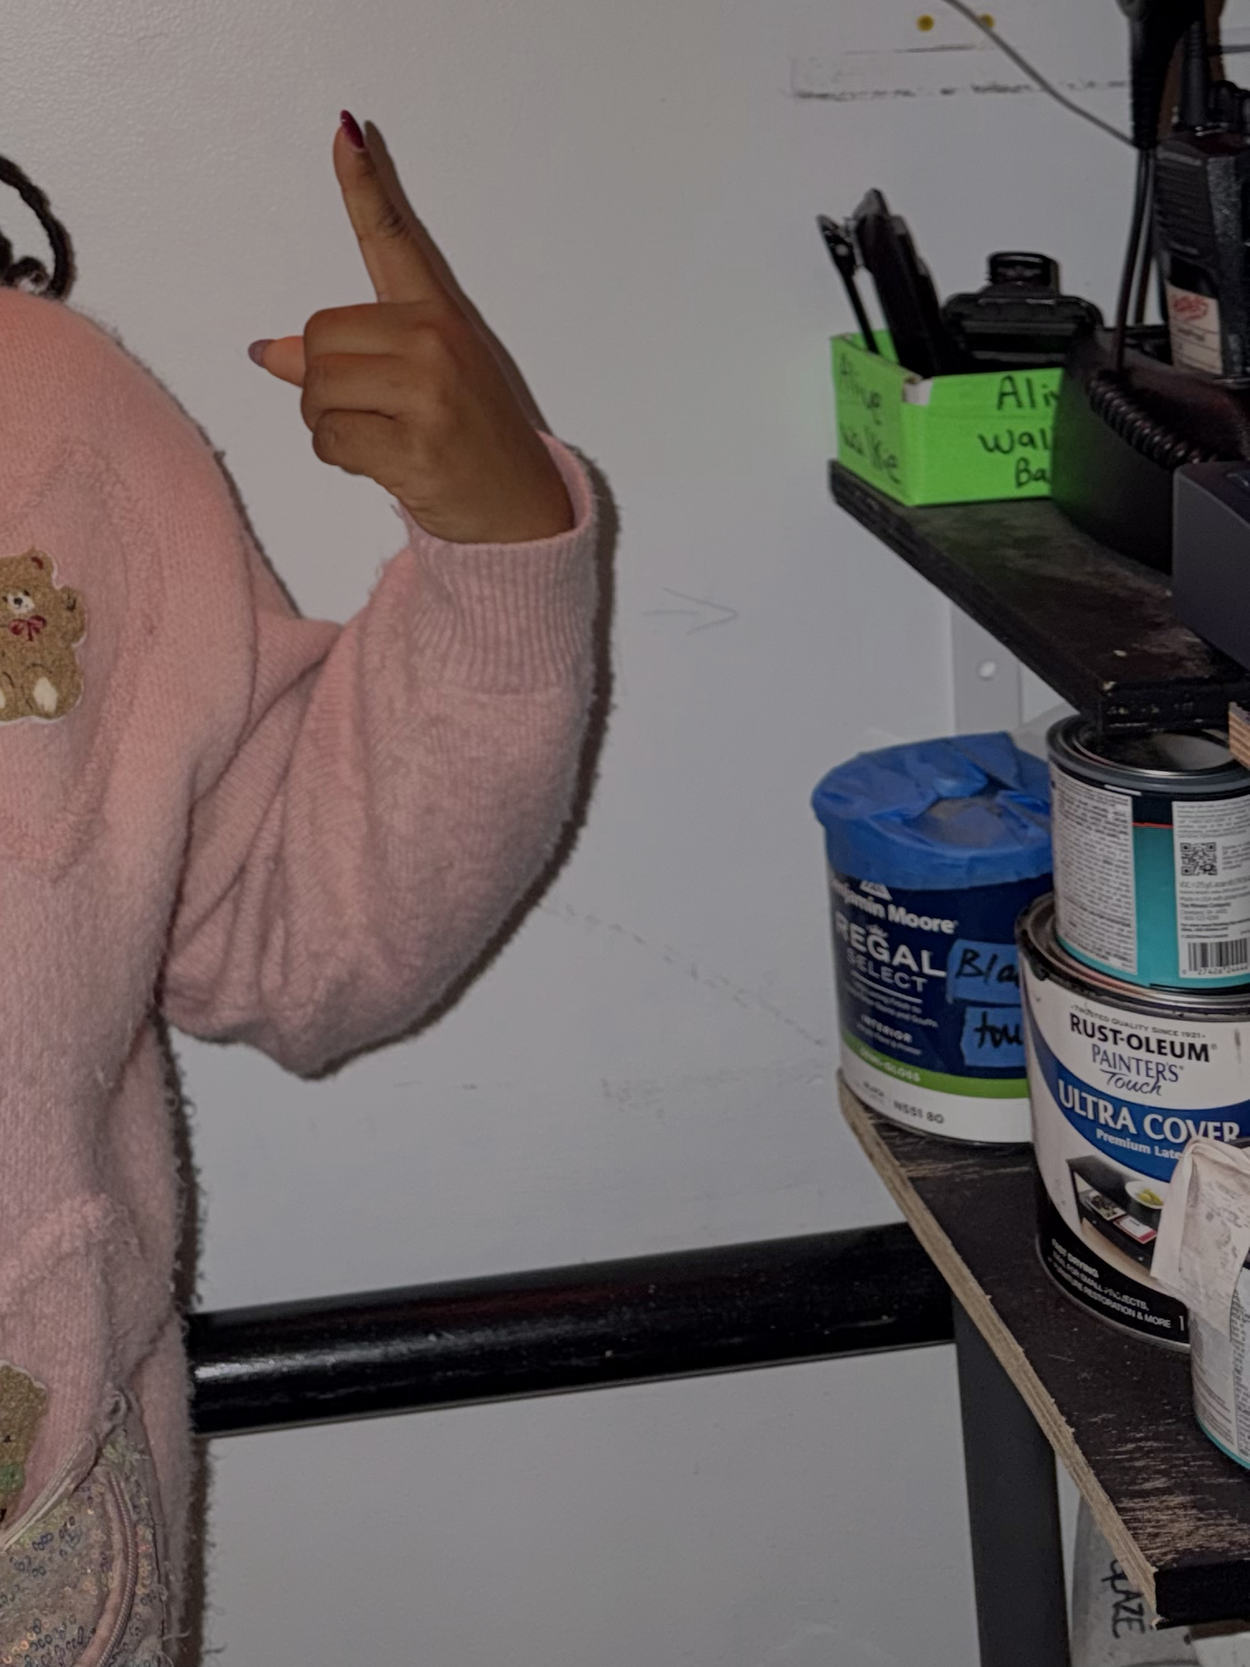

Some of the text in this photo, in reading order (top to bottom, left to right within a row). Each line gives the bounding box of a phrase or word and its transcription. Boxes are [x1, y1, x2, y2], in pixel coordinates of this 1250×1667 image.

[887, 903, 956, 935] Moore
[834, 910, 947, 978] REGAL
[847, 946, 928, 993] SELECT
[1069, 1012, 1210, 1062] RUST-OLEUM
[1111, 1017, 1149, 1032] QUALITY
[1151, 1026, 1179, 1038] SINCE
[1091, 1043, 1180, 1083] PAINTER'S
[1099, 1068, 1162, 1097] Touch
[1058, 1078, 1241, 1144] ULTRA COVER
[1096, 1128, 1151, 1154] Premium
[1144, 1313, 1172, 1328] MORE
